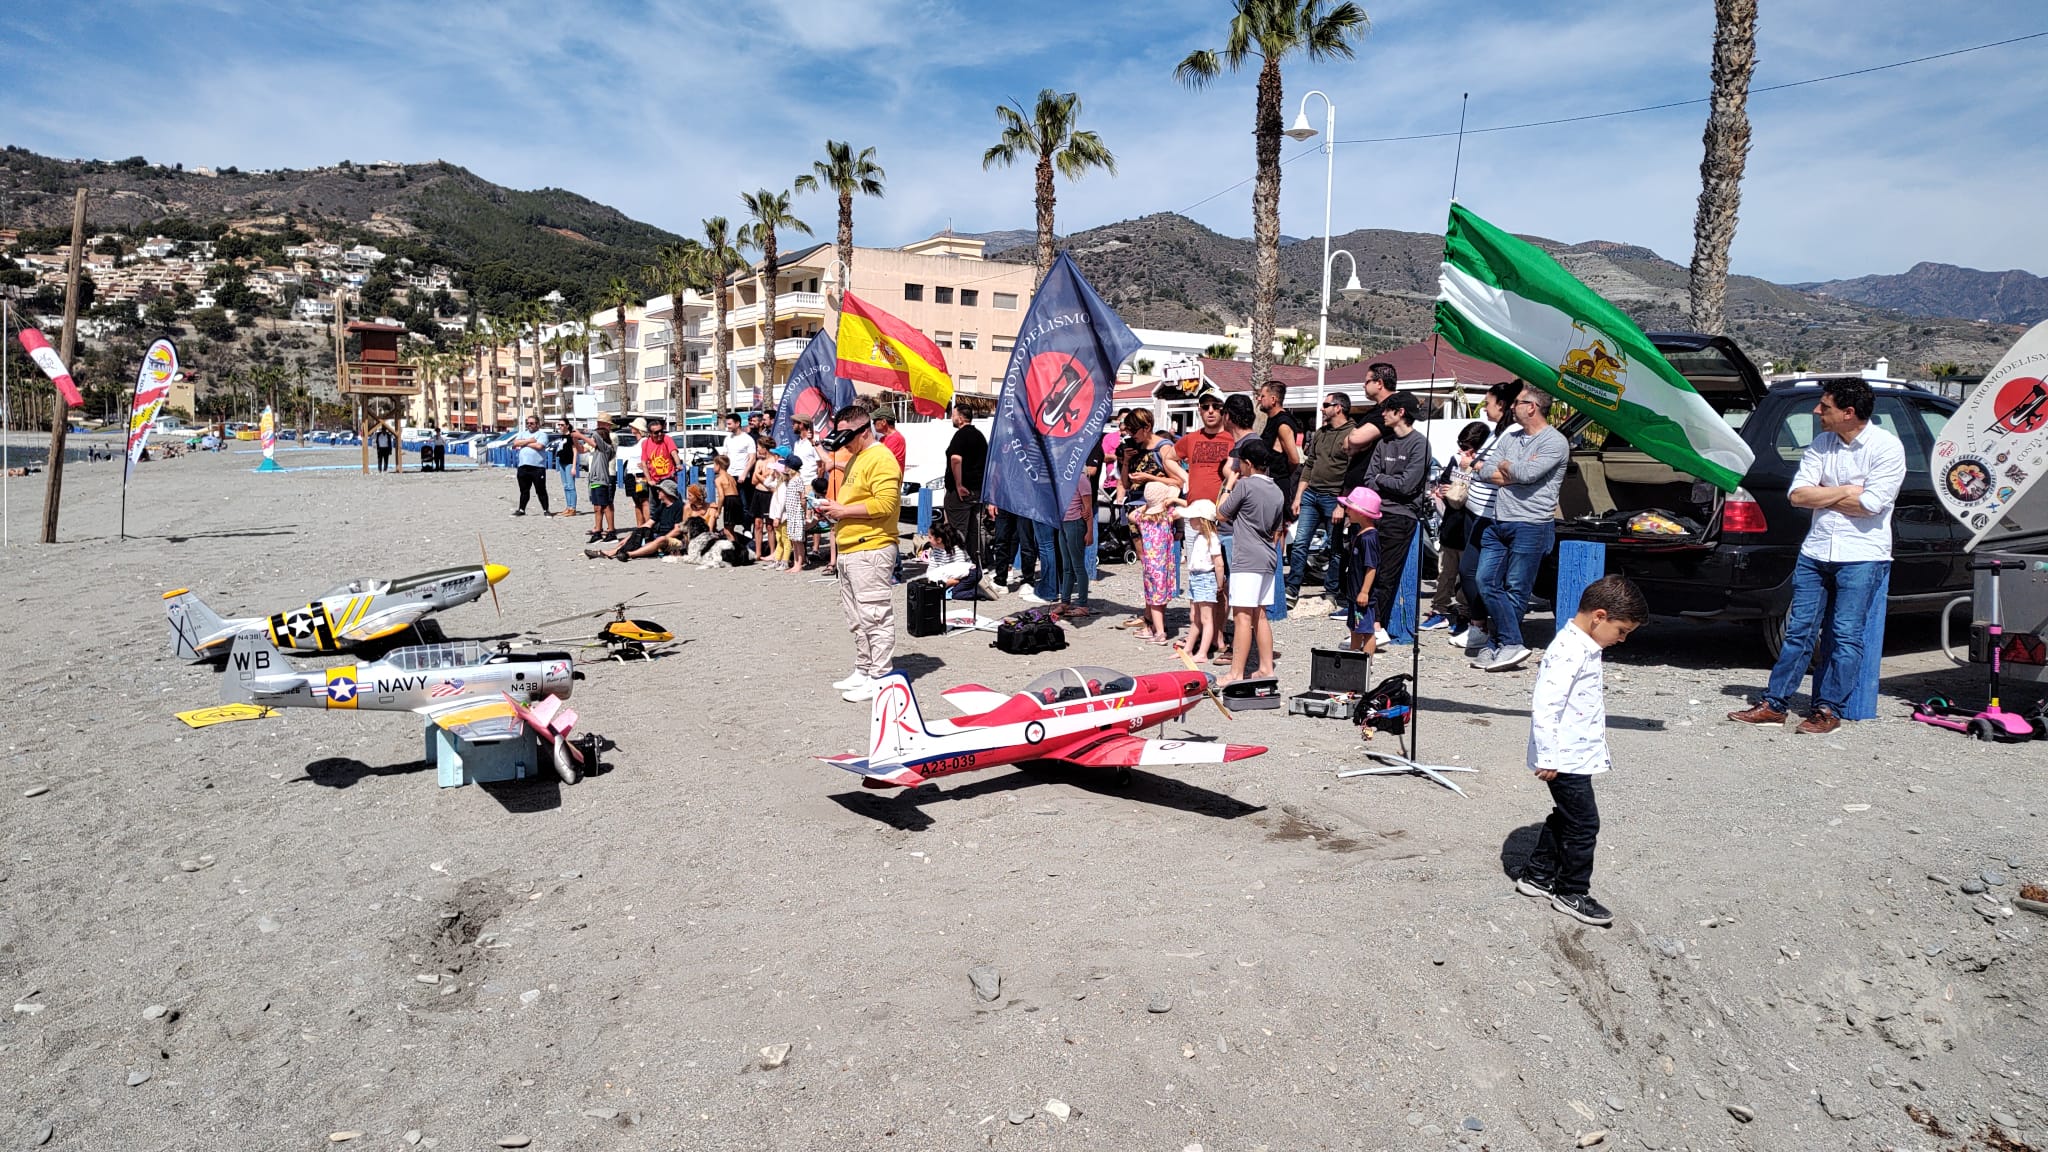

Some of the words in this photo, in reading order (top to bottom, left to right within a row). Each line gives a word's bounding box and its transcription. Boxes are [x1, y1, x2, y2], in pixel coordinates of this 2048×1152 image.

[1004, 311, 1091, 421] AEROMODELISMO
[1970, 352, 2048, 412] AEROMODELISM
[1966, 422, 1977, 453] CLUB
[1012, 438, 1039, 482] CLUB
[1063, 446, 1083, 481] COSTA
[377, 675, 428, 694] NAVY
[1128, 716, 1144, 729] 39
[920, 754, 976, 776] A23-039
